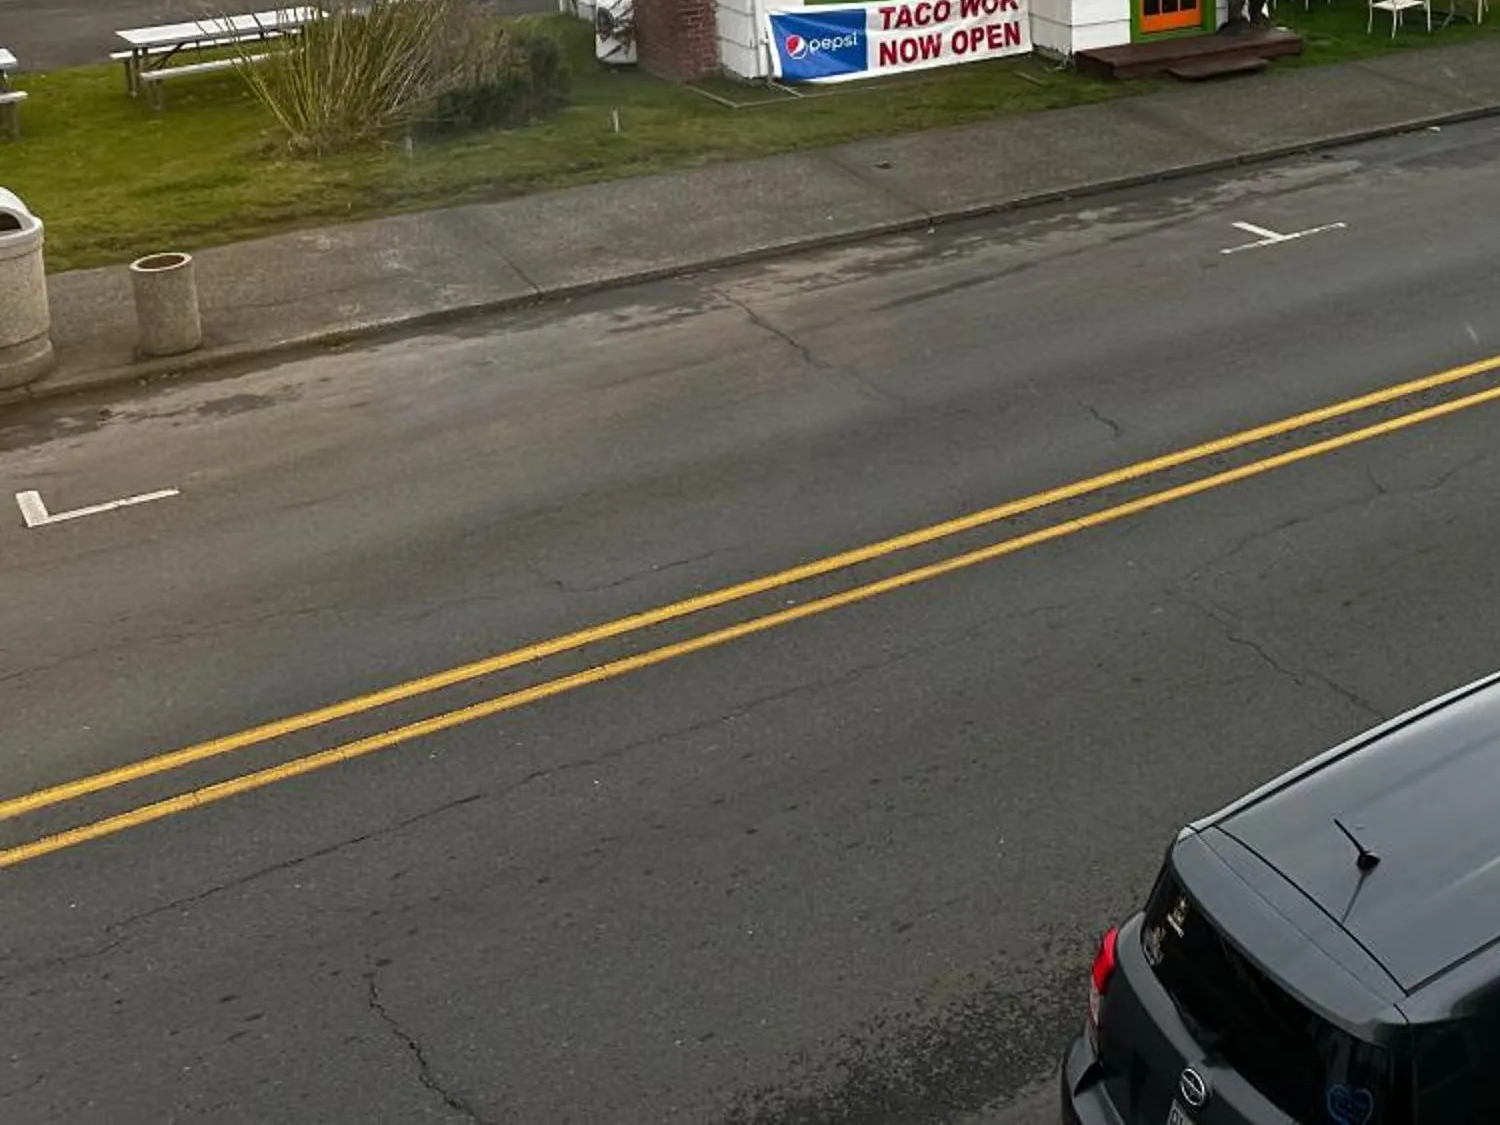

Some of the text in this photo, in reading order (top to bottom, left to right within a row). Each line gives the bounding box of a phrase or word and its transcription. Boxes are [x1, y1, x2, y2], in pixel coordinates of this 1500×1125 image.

[879, 0, 951, 30] TACO
[809, 30, 858, 54] pepsi
[879, 21, 1021, 66] NOW OPEN
